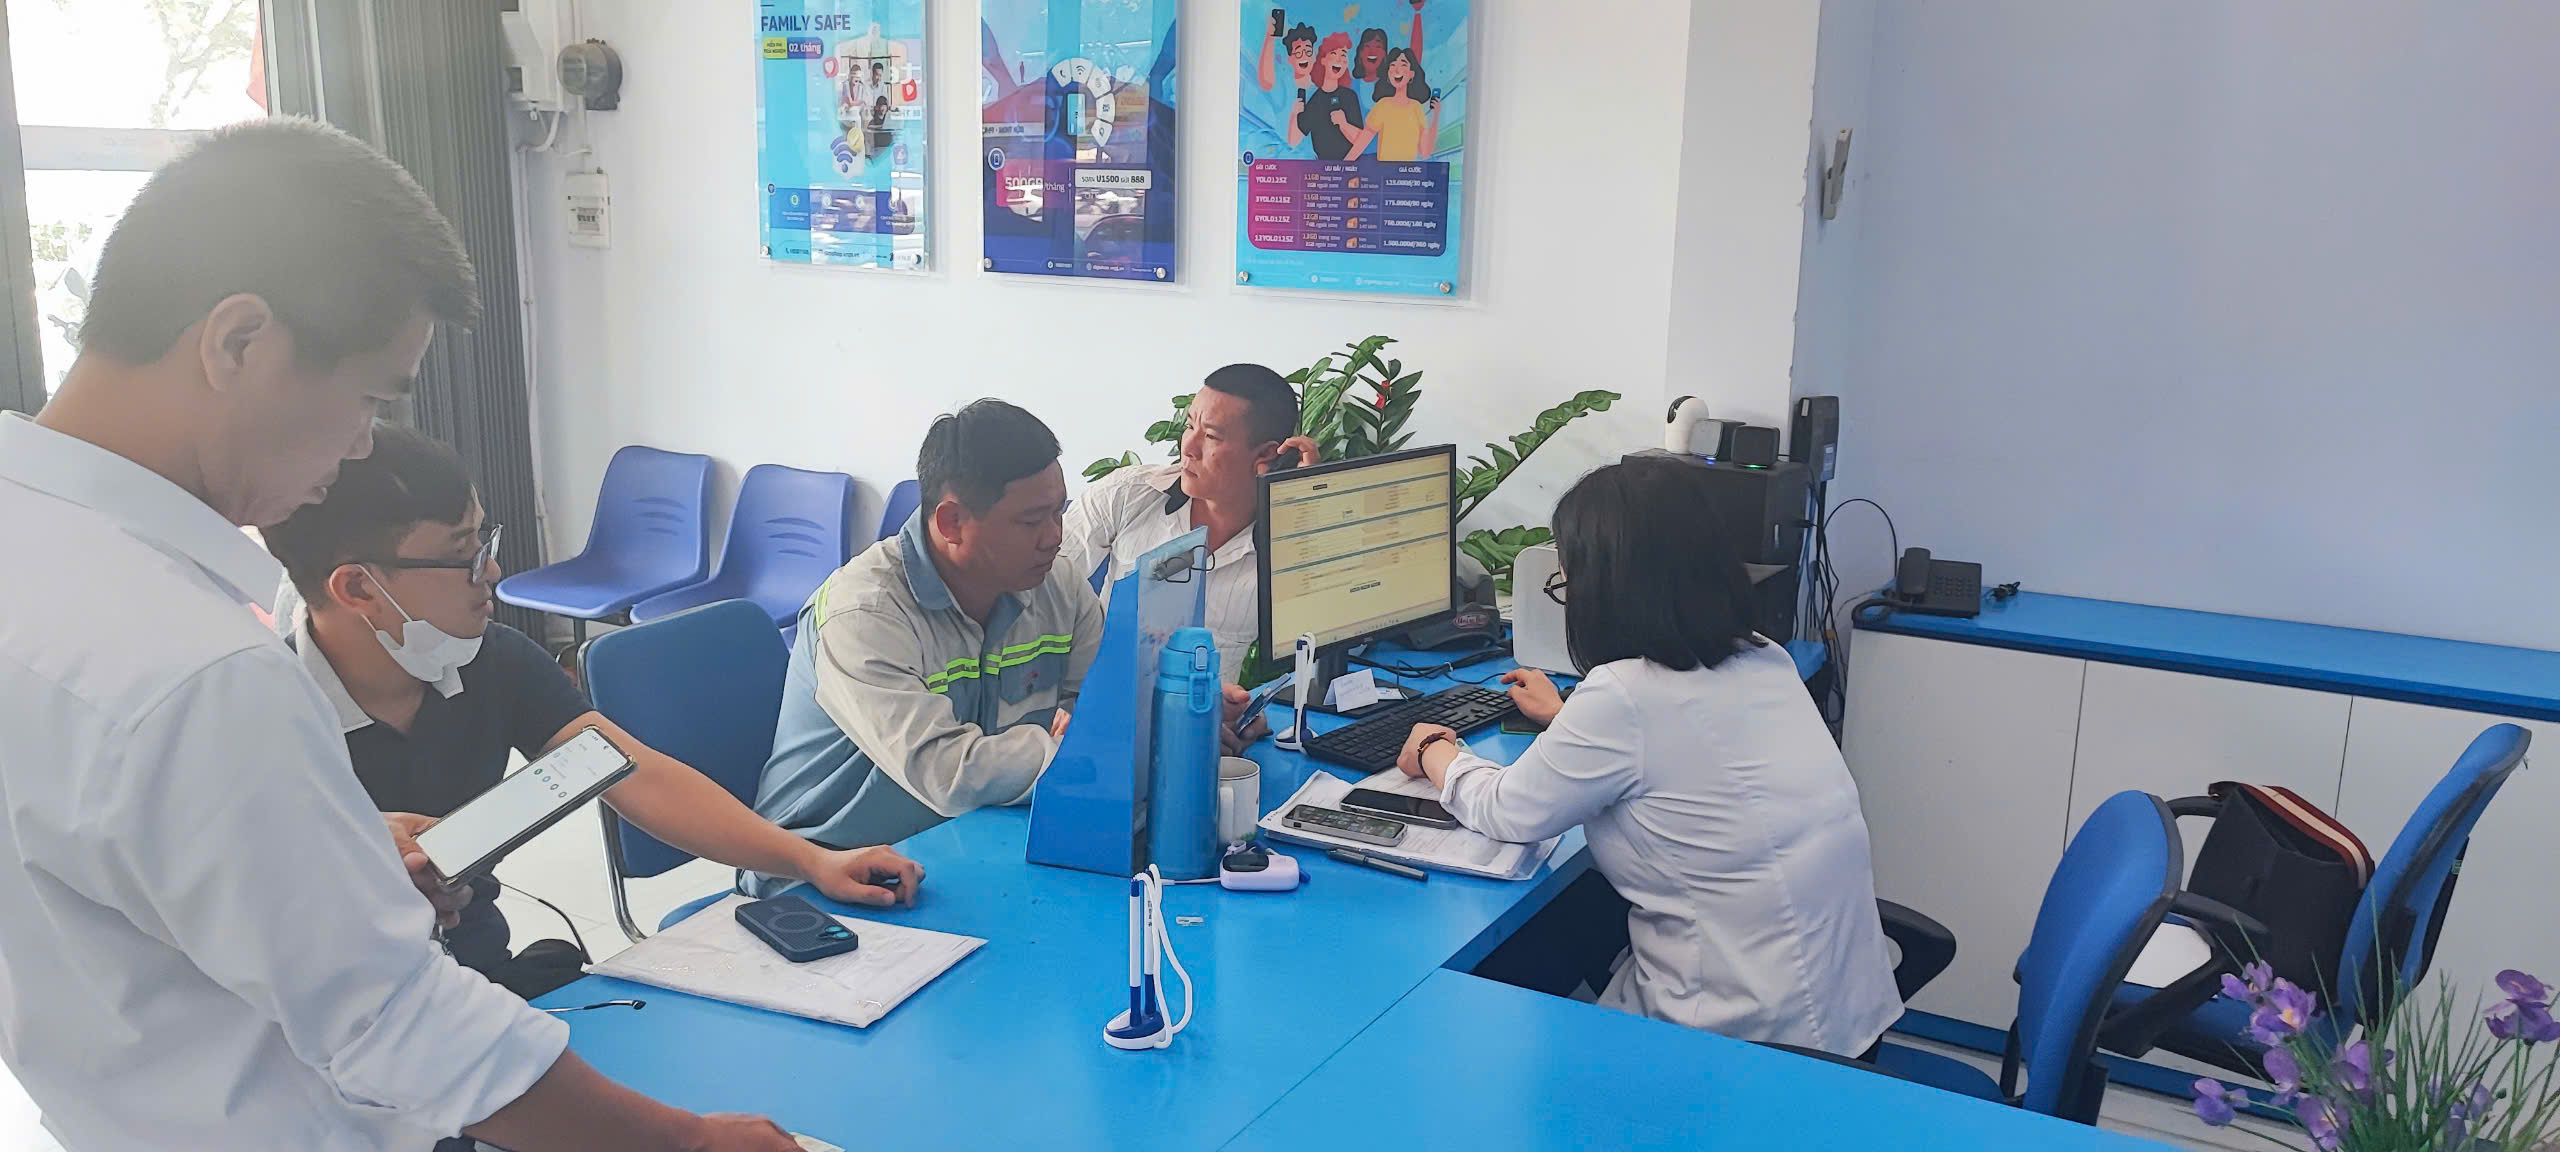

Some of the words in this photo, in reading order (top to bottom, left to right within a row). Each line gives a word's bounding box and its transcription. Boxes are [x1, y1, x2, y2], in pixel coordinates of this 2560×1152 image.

[761, 15, 810, 32] FAMILY
[815, 14, 851, 31] SAFE
[789, 43, 799, 53] 02
[800, 42, 822, 55] tháng
[1130, 175, 1145, 184] 888
